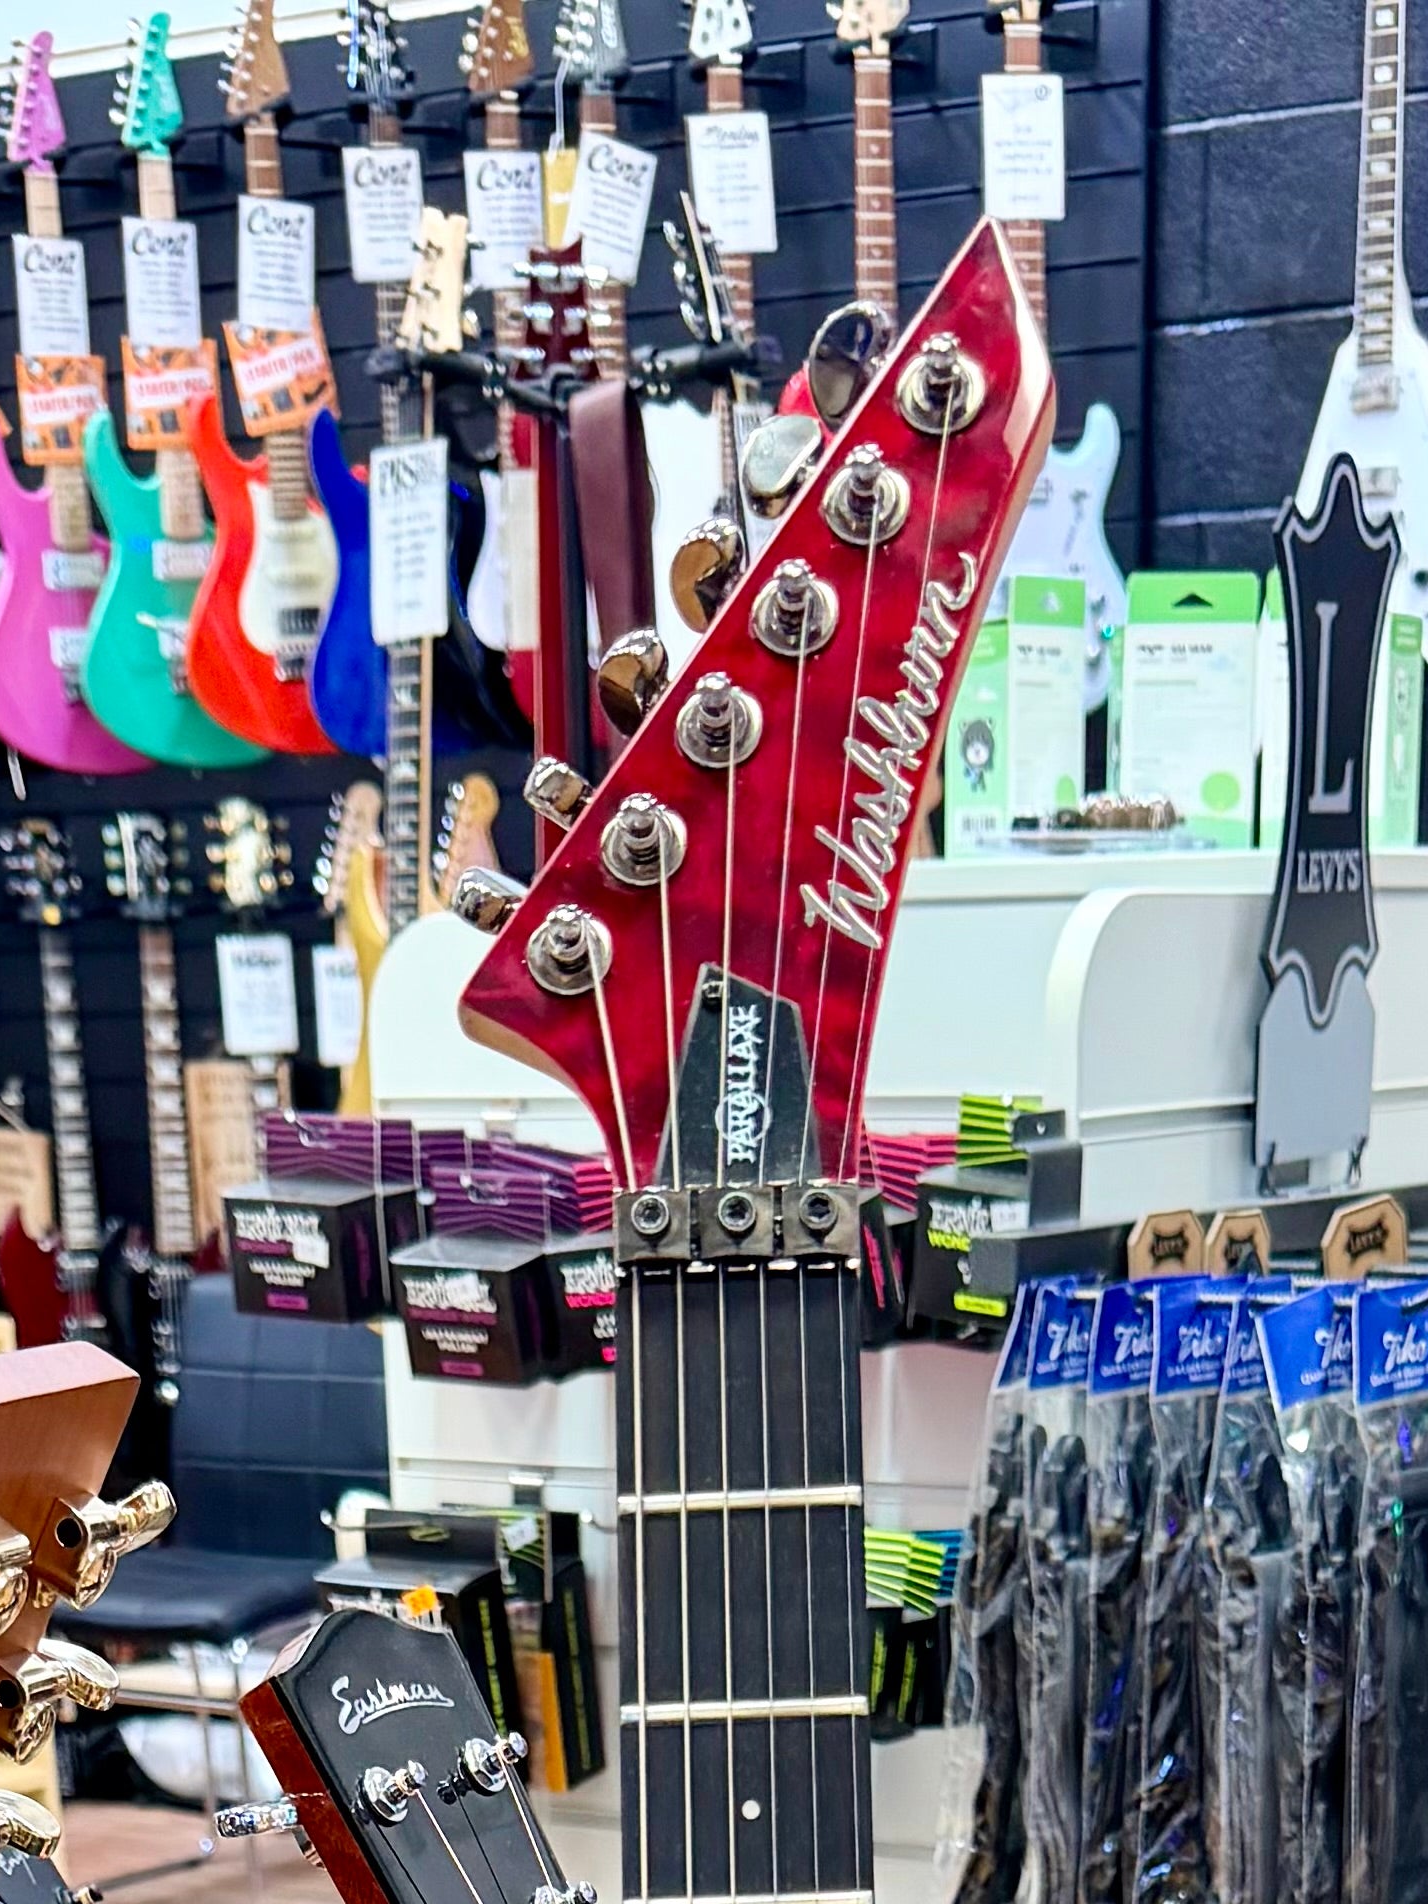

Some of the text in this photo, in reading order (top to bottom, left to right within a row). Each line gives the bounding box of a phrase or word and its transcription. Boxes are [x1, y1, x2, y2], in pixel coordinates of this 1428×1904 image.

[353, 157, 413, 189] Cort
[477, 159, 536, 191] Cort
[248, 206, 305, 237] Cort
[132, 228, 189, 257] Cort
[24, 245, 76, 276] Cort
[800, 552, 977, 949] Washburn
[332, 1675, 455, 1735] Eastman
